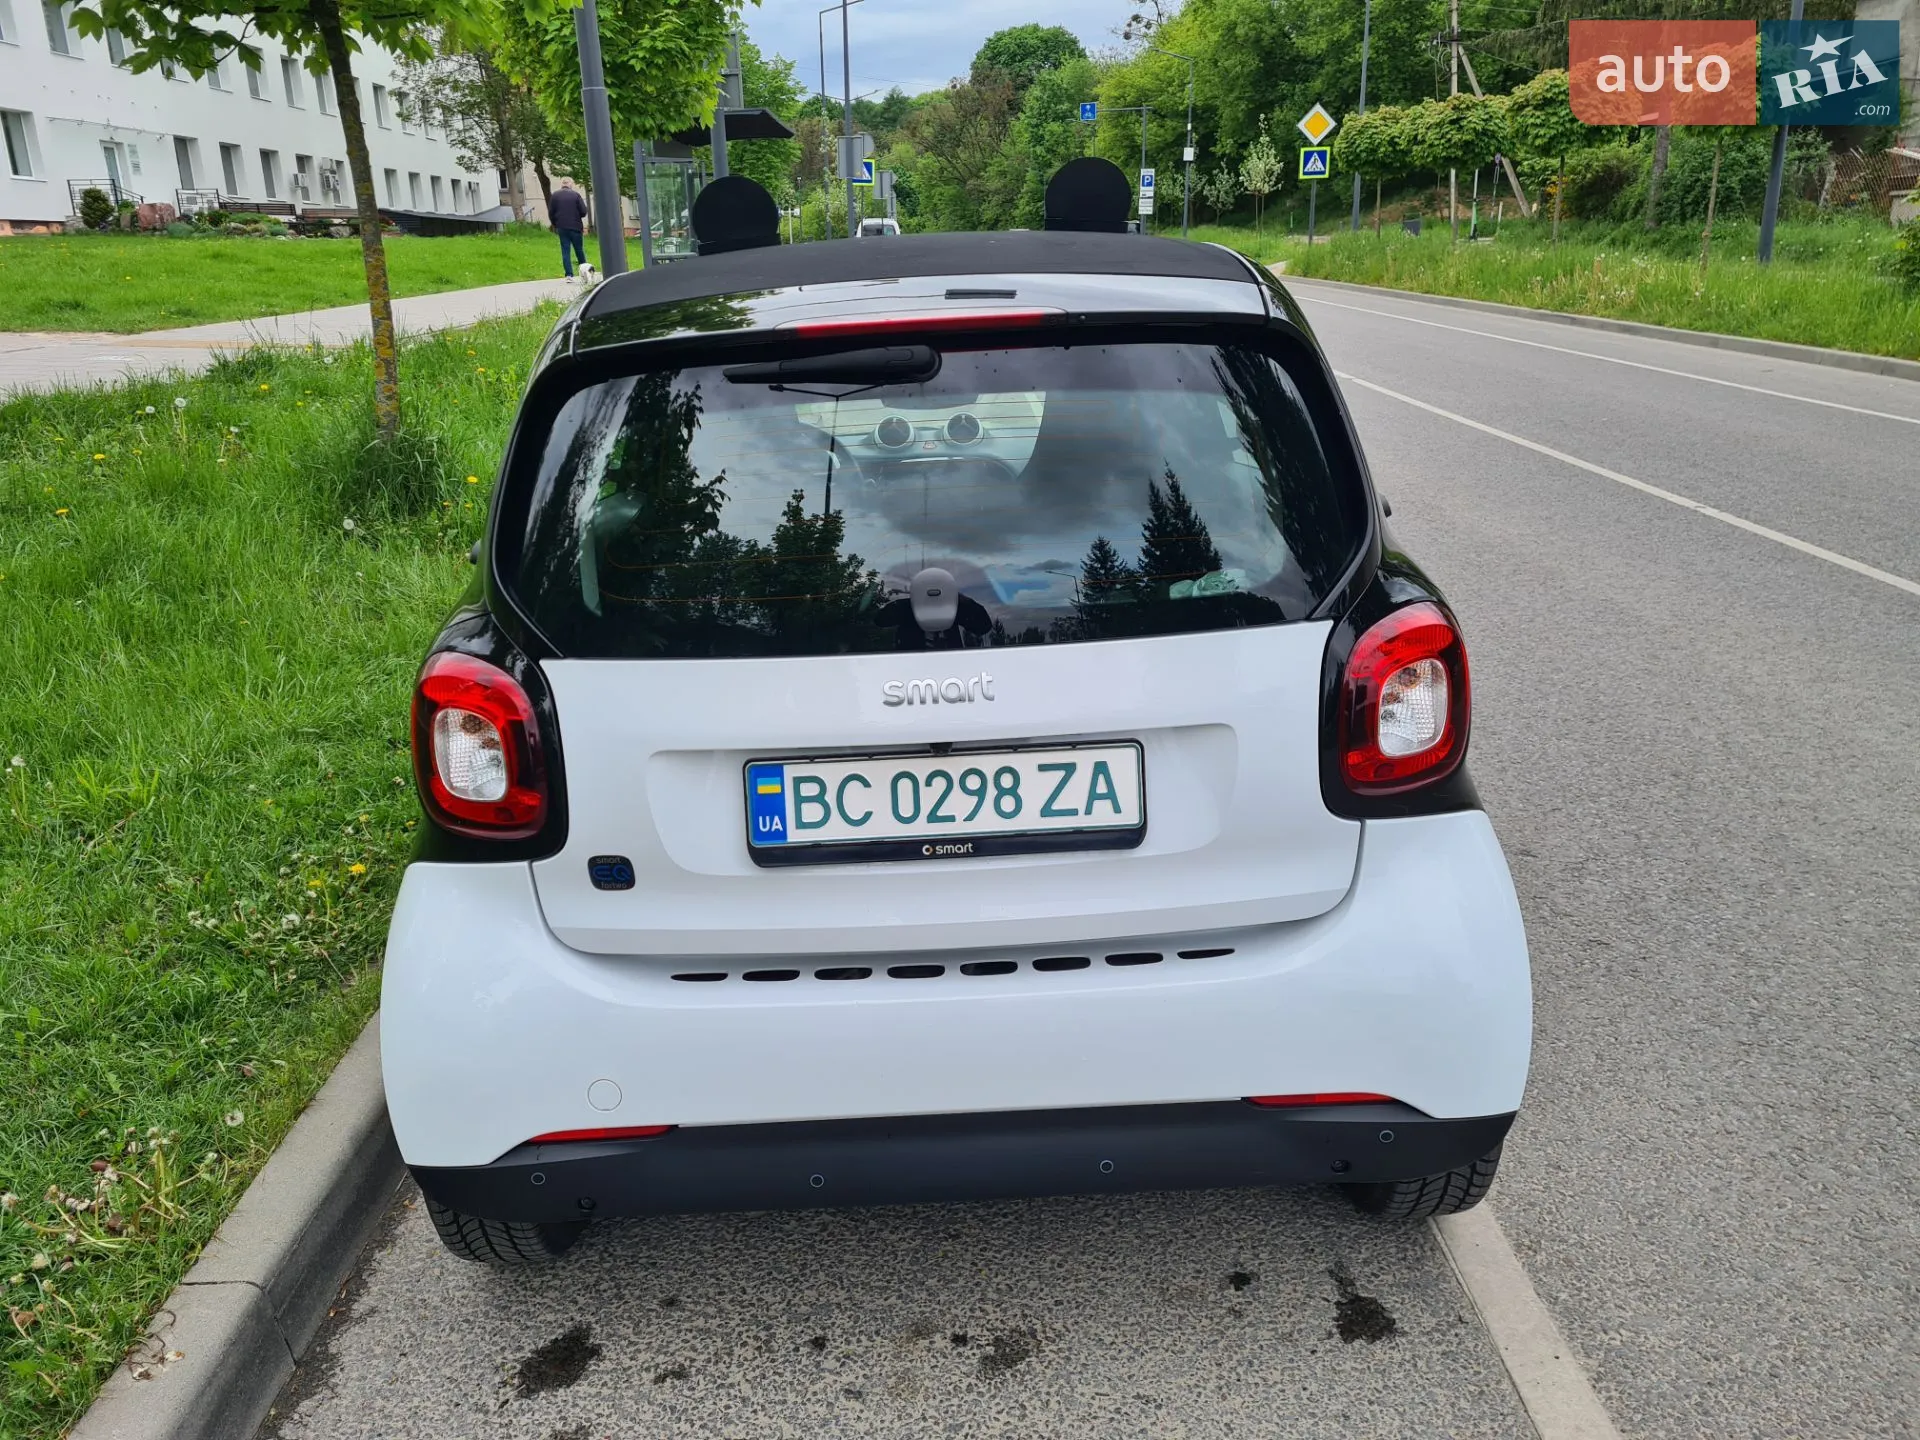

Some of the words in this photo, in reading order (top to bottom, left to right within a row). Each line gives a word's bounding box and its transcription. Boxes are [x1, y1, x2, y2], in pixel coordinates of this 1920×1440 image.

[882, 671, 995, 707] smart
[792, 773, 873, 830] BC
[890, 765, 1022, 825] 0298
[1037, 761, 1122, 817] ZA
[758, 815, 783, 832] UA
[935, 842, 974, 855] smart
